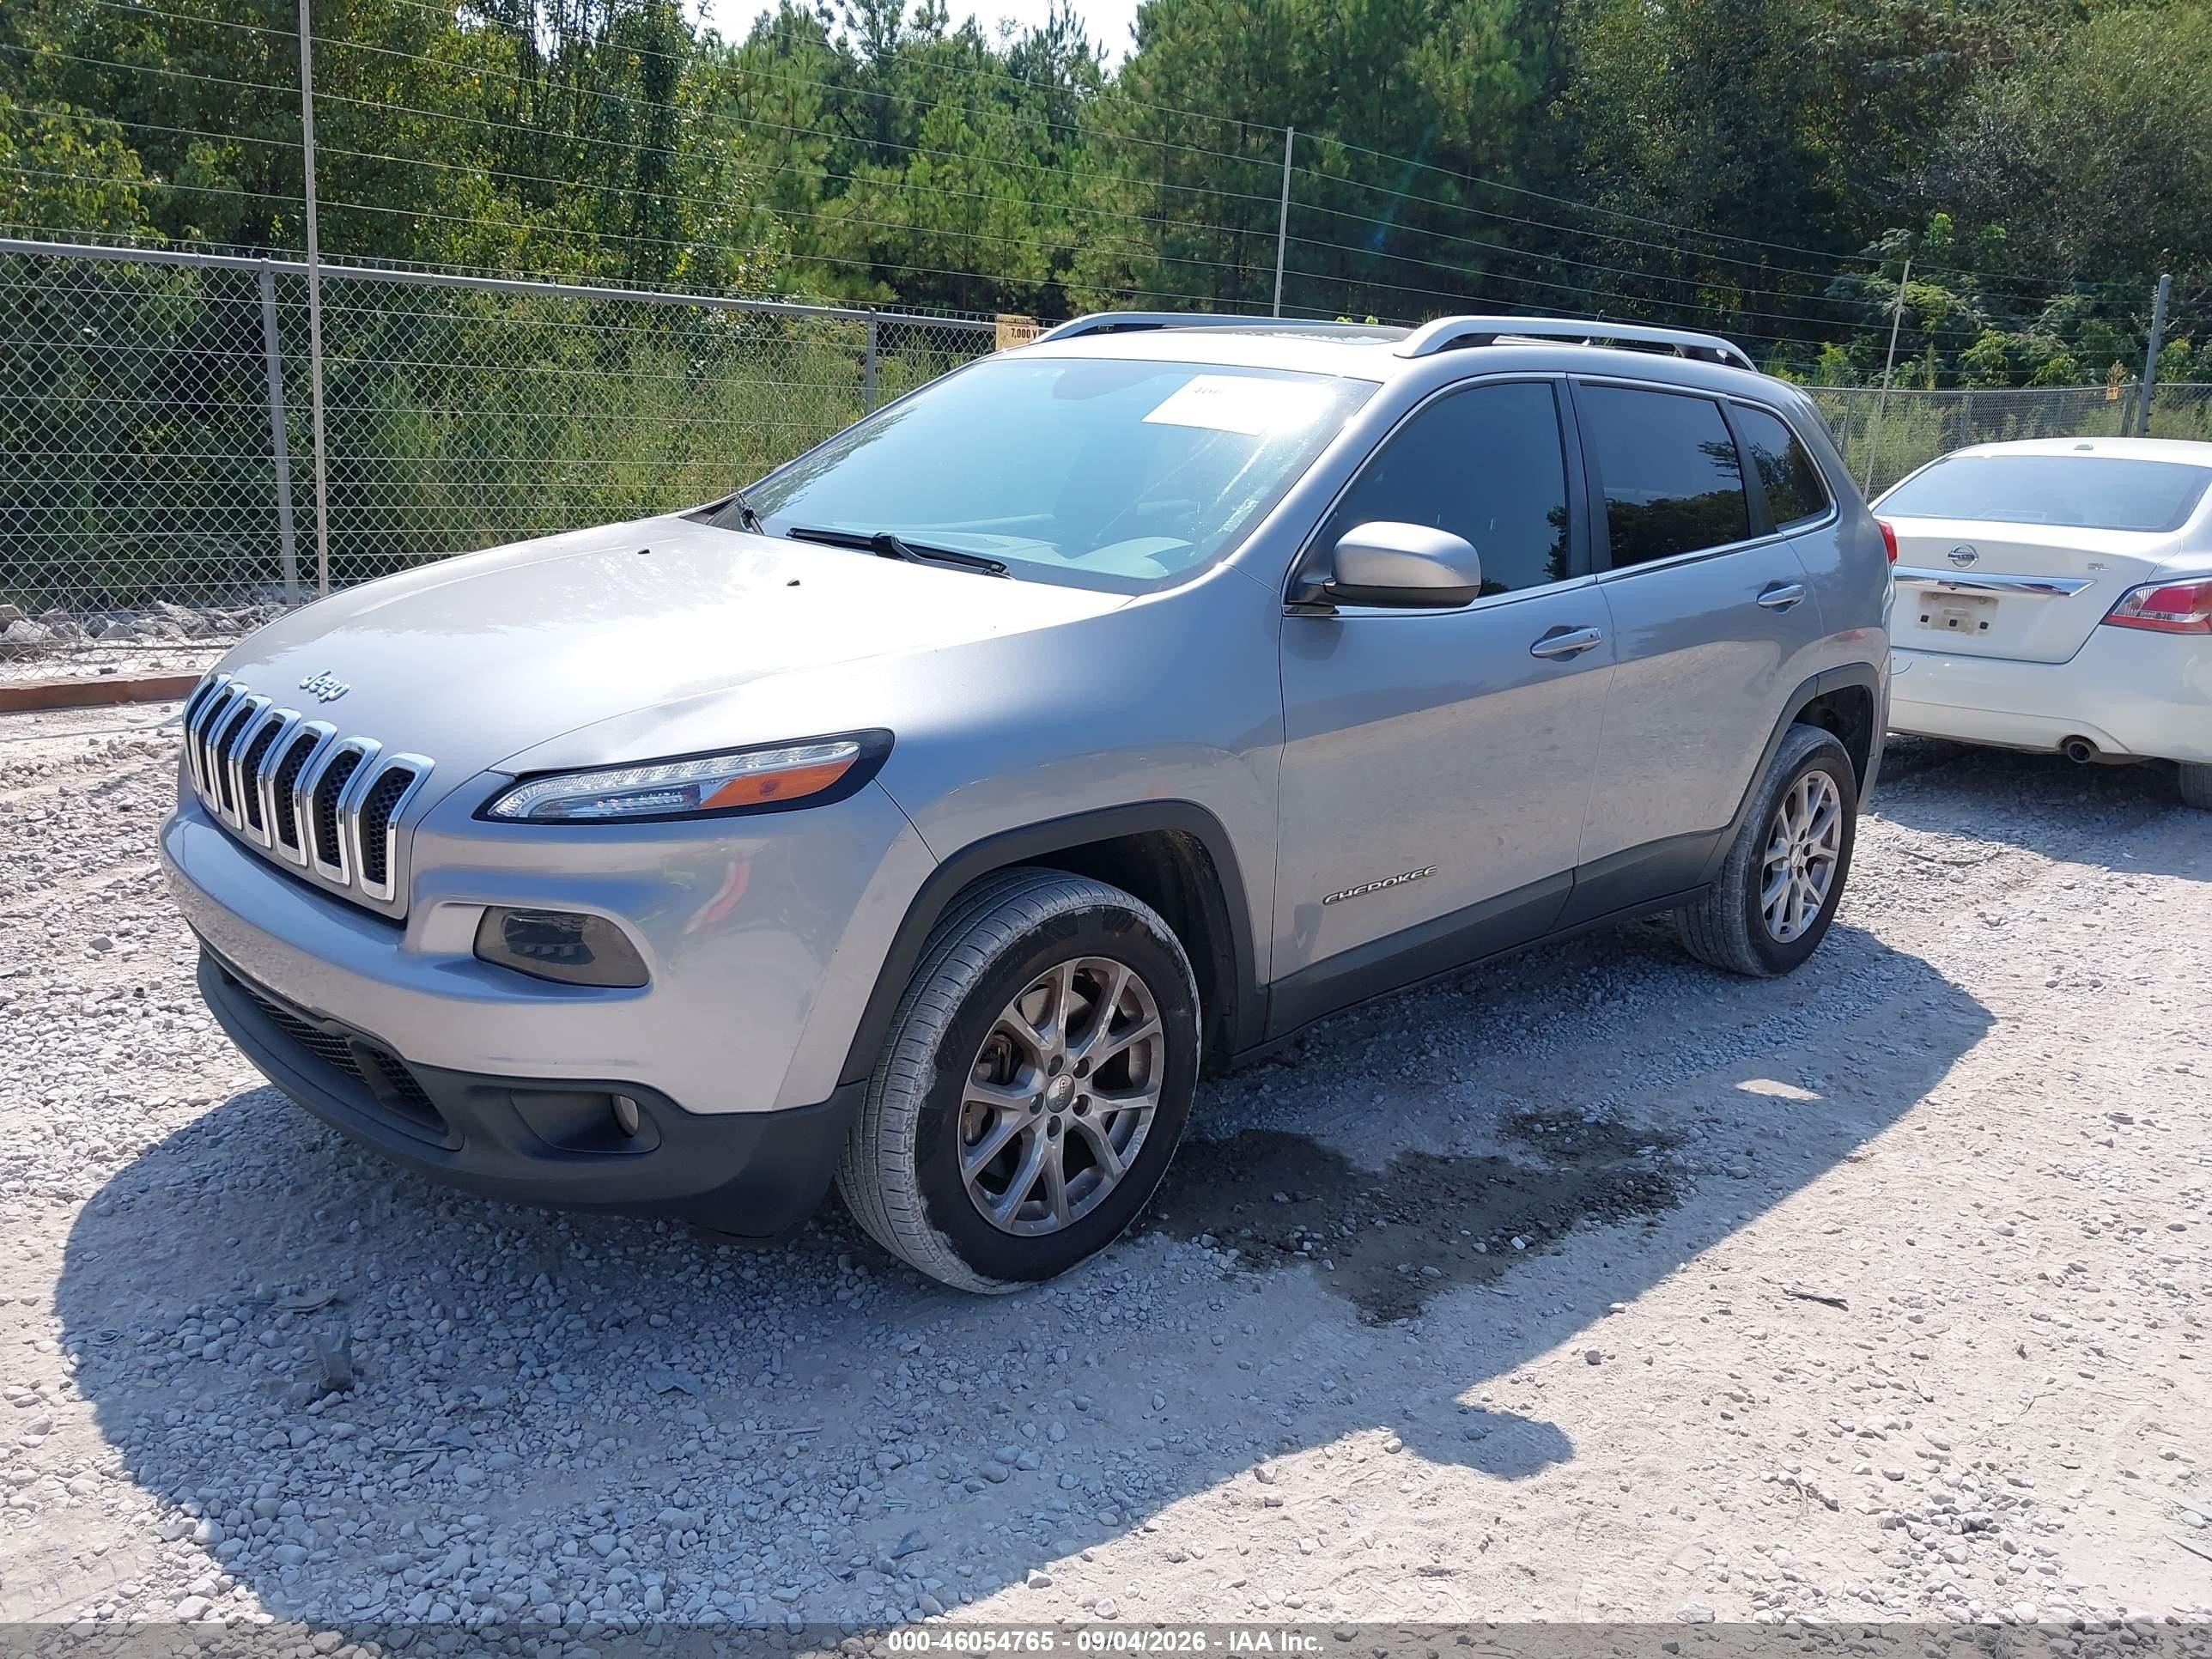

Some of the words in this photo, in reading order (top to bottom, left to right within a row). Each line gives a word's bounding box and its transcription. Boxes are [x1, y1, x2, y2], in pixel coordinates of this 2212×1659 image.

[1011, 328, 1031, 339] 7,000
[298, 669, 351, 704] Jeep
[1322, 865, 1437, 905] CHEROKEE
